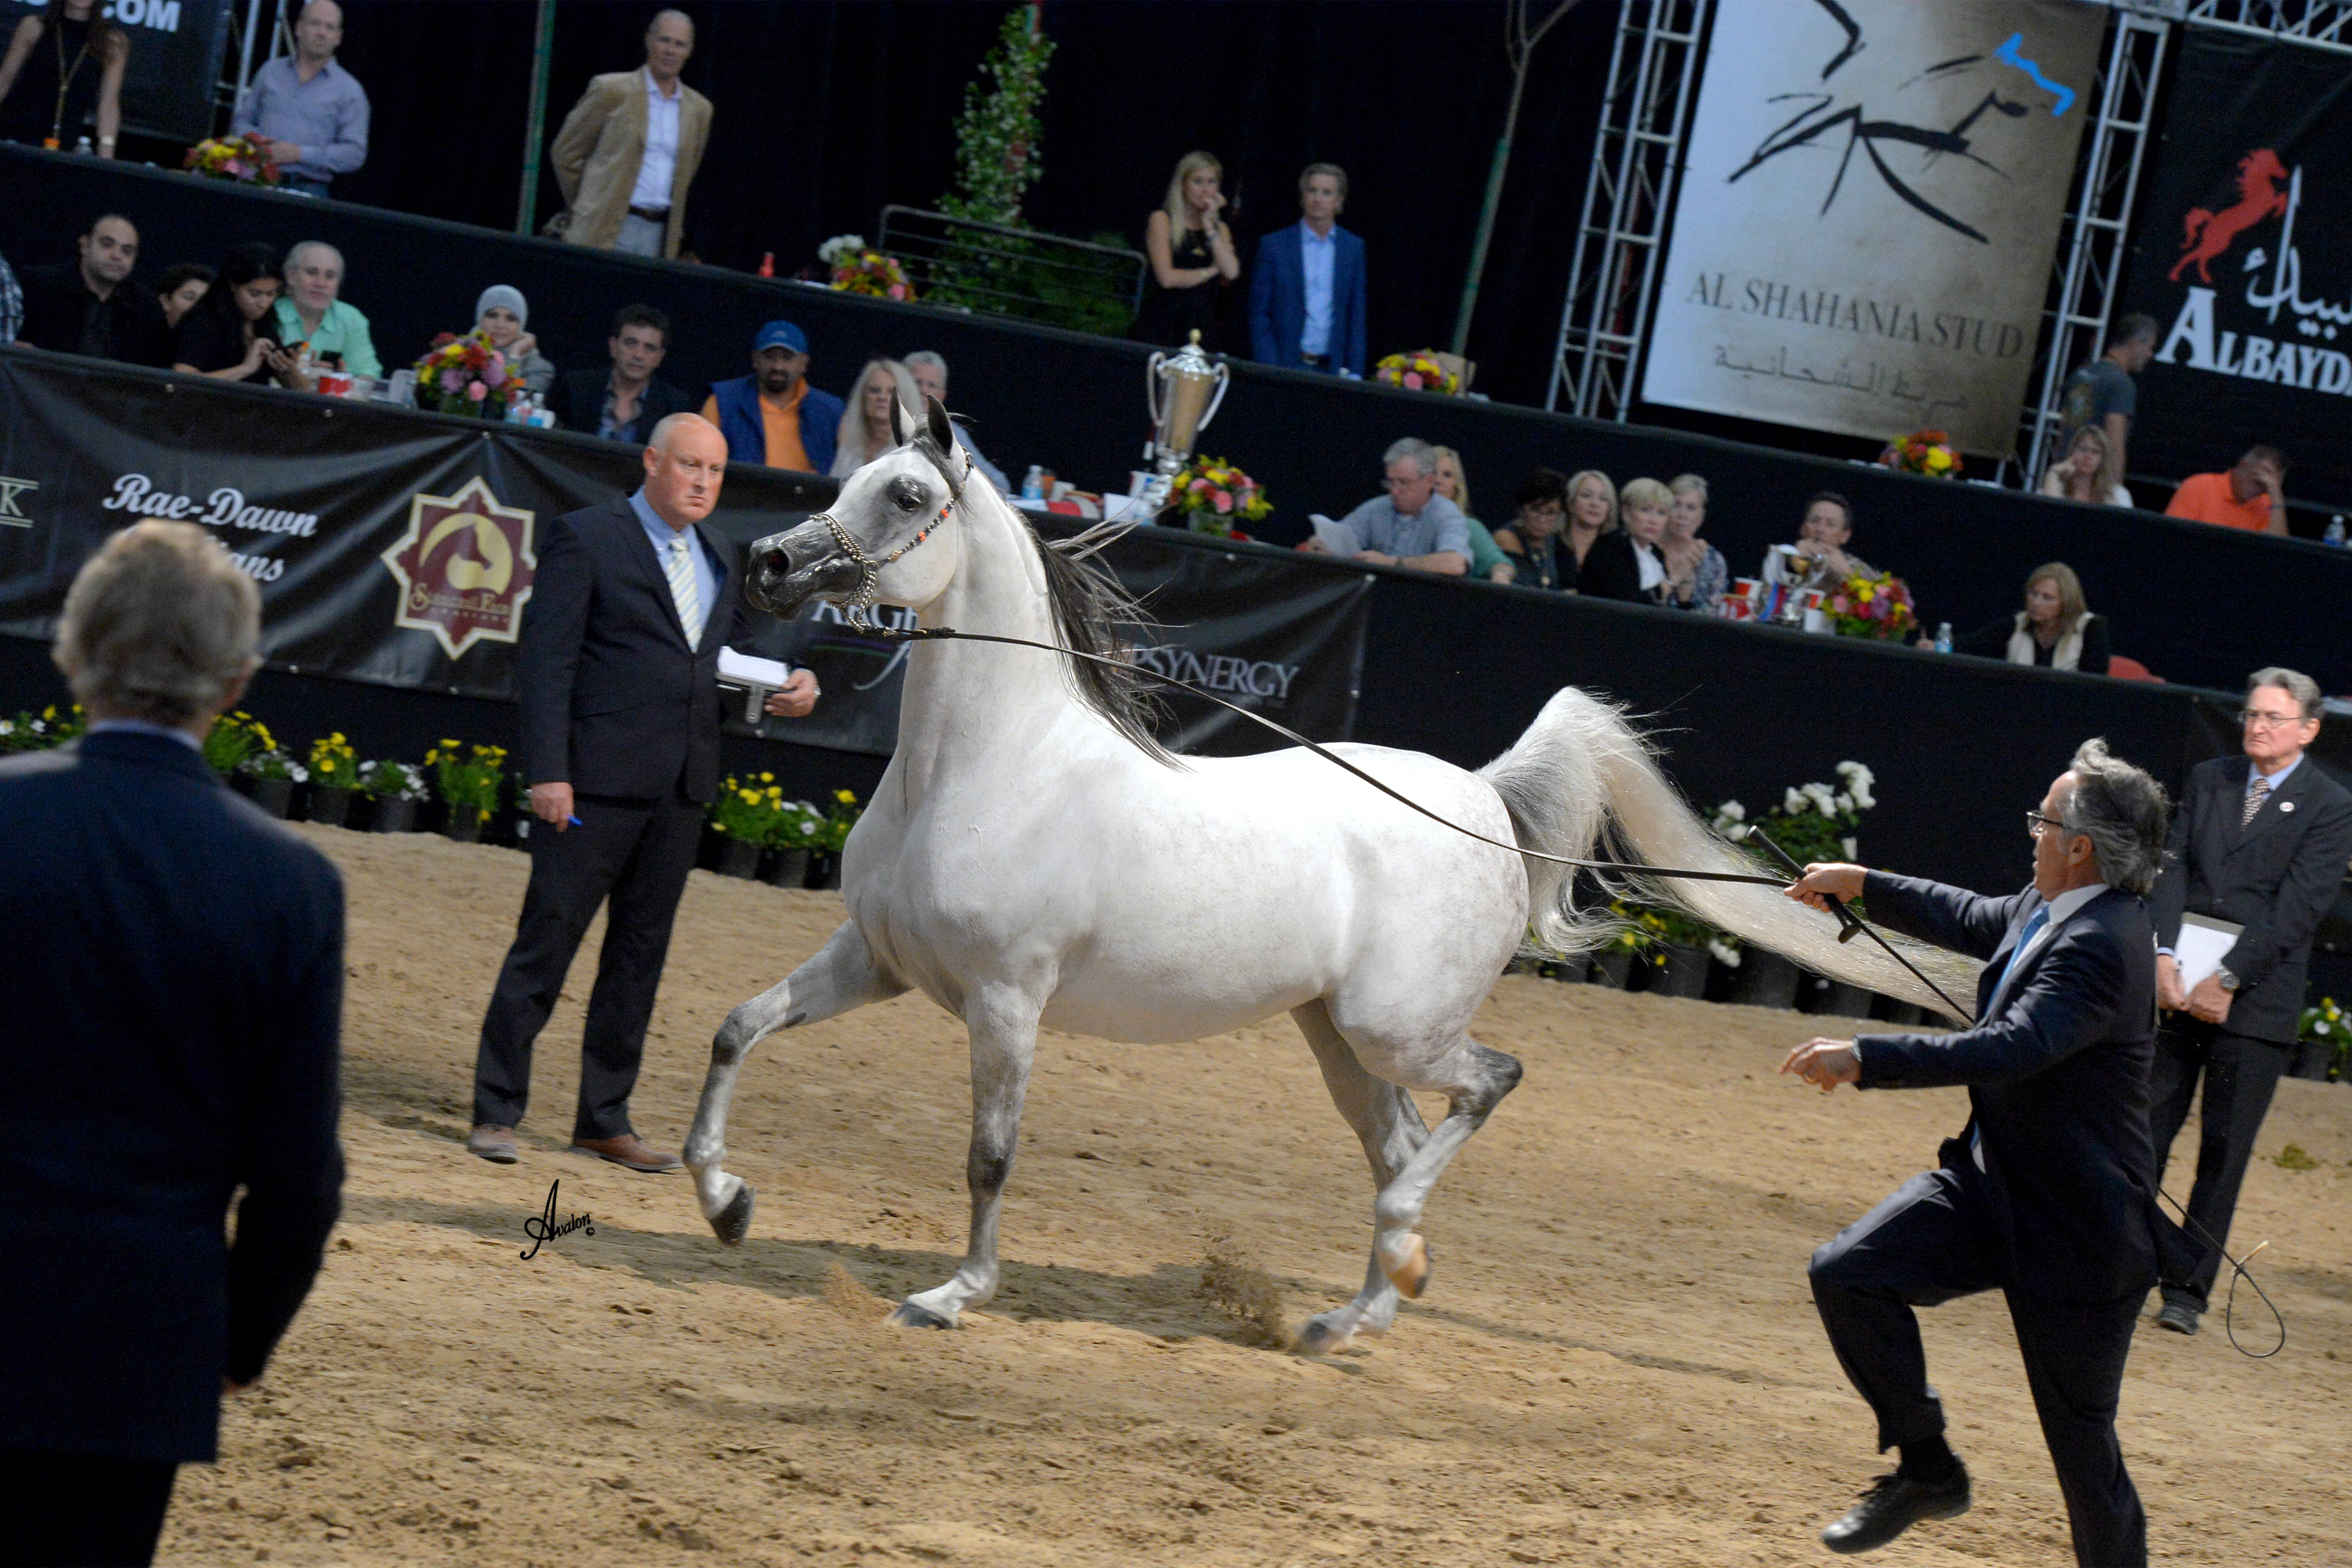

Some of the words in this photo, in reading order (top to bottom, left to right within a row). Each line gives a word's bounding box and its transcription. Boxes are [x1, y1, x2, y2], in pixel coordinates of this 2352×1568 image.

[1686, 272, 1732, 310] AL
[1740, 277, 1920, 344] SHAHANIA
[1929, 311, 2025, 359] STUD
[2155, 286, 2352, 397] ALBAYD
[103, 473, 319, 538] Rae-Dawn
